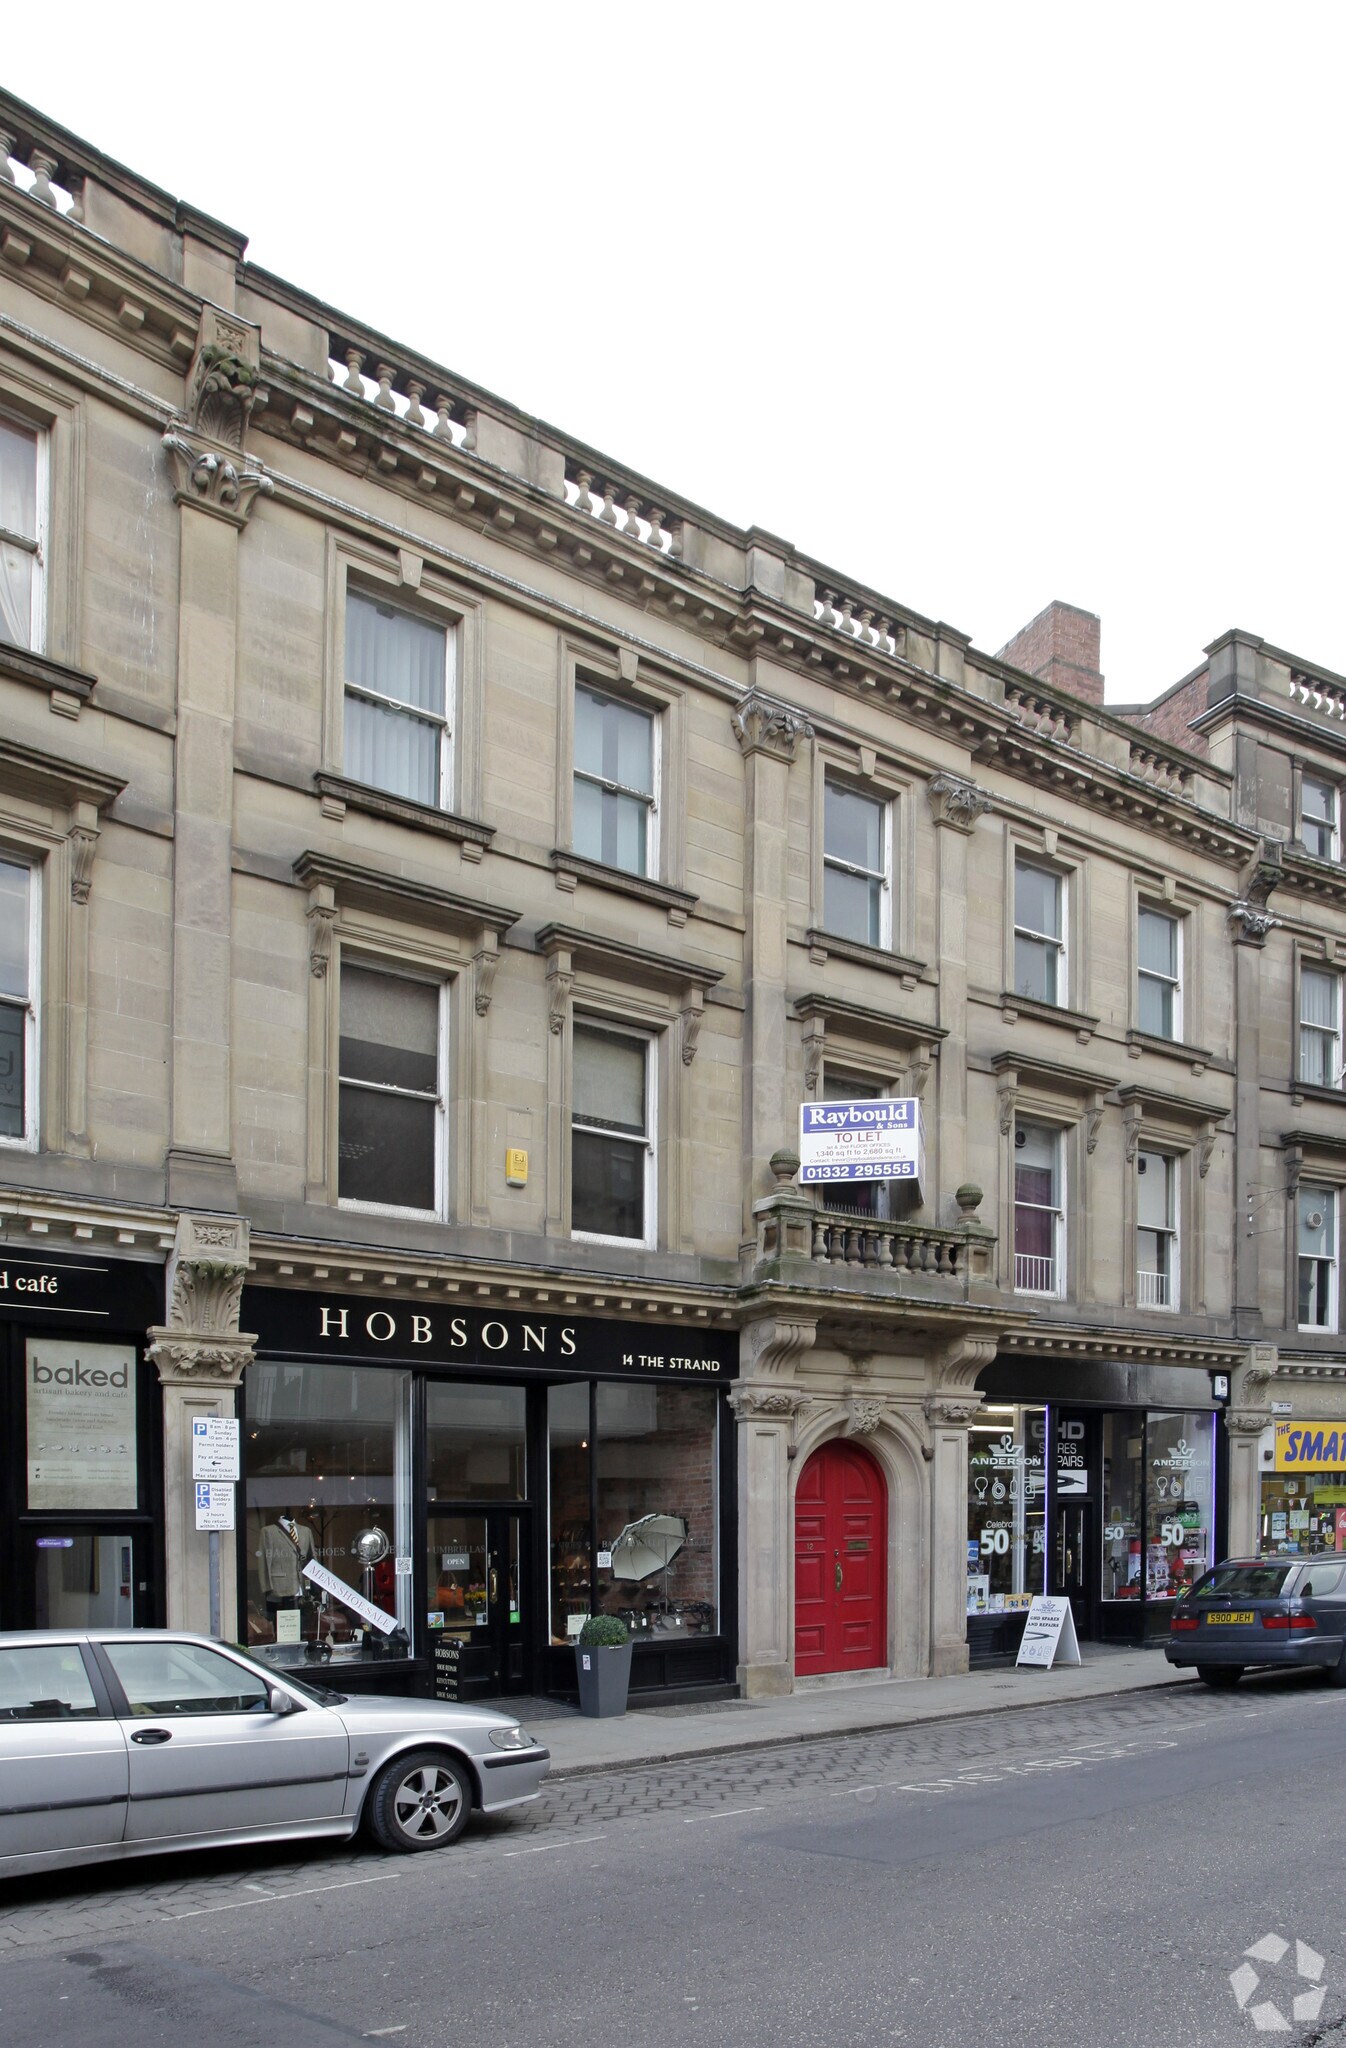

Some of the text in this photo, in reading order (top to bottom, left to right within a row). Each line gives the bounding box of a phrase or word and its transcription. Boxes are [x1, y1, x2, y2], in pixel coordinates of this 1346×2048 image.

[810, 1104, 908, 1127] Raybould
[834, 1131, 883, 1143] TO LET
[863, 1148, 883, 1156] 2,680
[807, 1163, 911, 1179] 01332 295555
[16, 1275, 58, 1294] café
[319, 1306, 577, 1356] HOBSONS
[623, 1354, 720, 1372] 14 THE STRAND
[33, 1356, 128, 1389] baked
[65, 1389, 93, 1398] bakery
[1277, 1423, 1290, 1436] THE
[1038, 1442, 1077, 1454] SRES
[1284, 1431, 1346, 1463] SMA
[970, 1457, 1041, 1466] ANDERSON
[1153, 1459, 1209, 1467] ANDERSON
[986, 1521, 1023, 1530] Celebra
[1105, 1527, 1124, 1539] 50
[1162, 1524, 1184, 1546] 50
[807, 1543, 814, 1551] 12
[981, 1530, 1009, 1555] 50
[313, 1547, 345, 1557] SHOES
[433, 1544, 486, 1554] UMBRELLAS
[309, 1565, 390, 1629] MENS SHOE SALE
[1211, 1613, 1251, 1623] S900 JEH
[435, 1648, 459, 1660] HOBSONS
